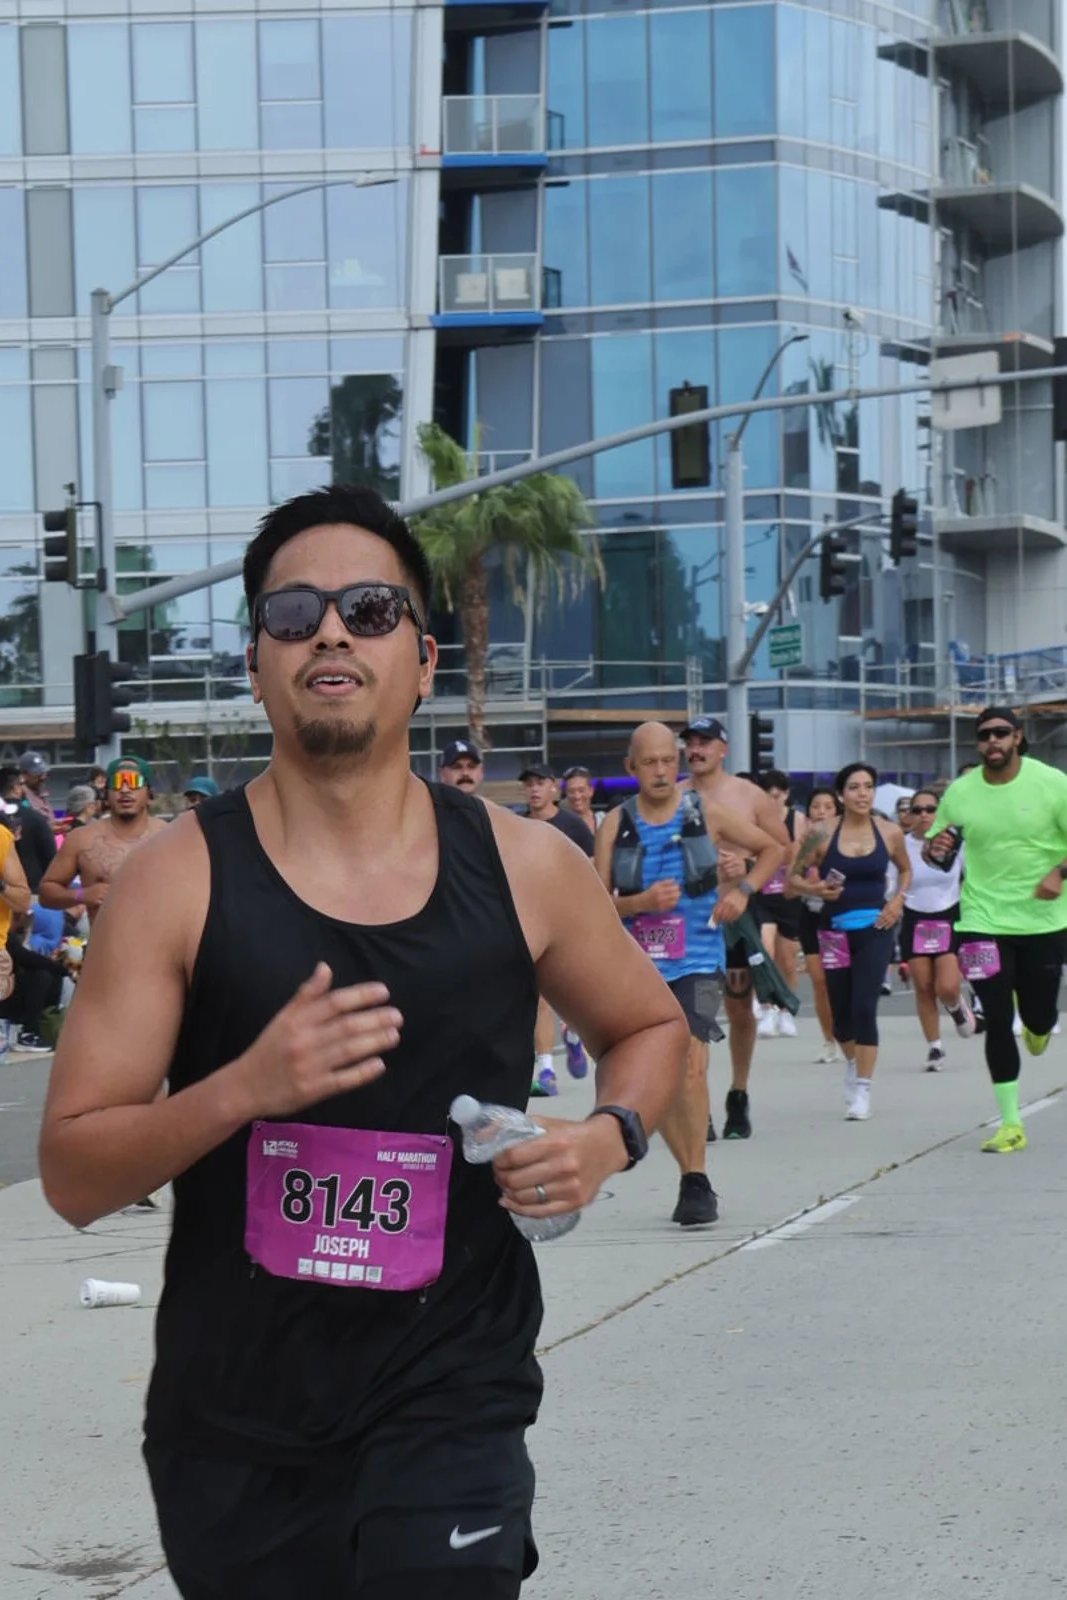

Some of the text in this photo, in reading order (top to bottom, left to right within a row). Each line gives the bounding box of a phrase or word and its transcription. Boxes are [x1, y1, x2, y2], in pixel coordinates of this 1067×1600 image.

[377, 1151, 437, 1164] HALF MARATHON
[280, 1168, 412, 1234] 8143
[312, 1234, 370, 1259] JOSEPH
